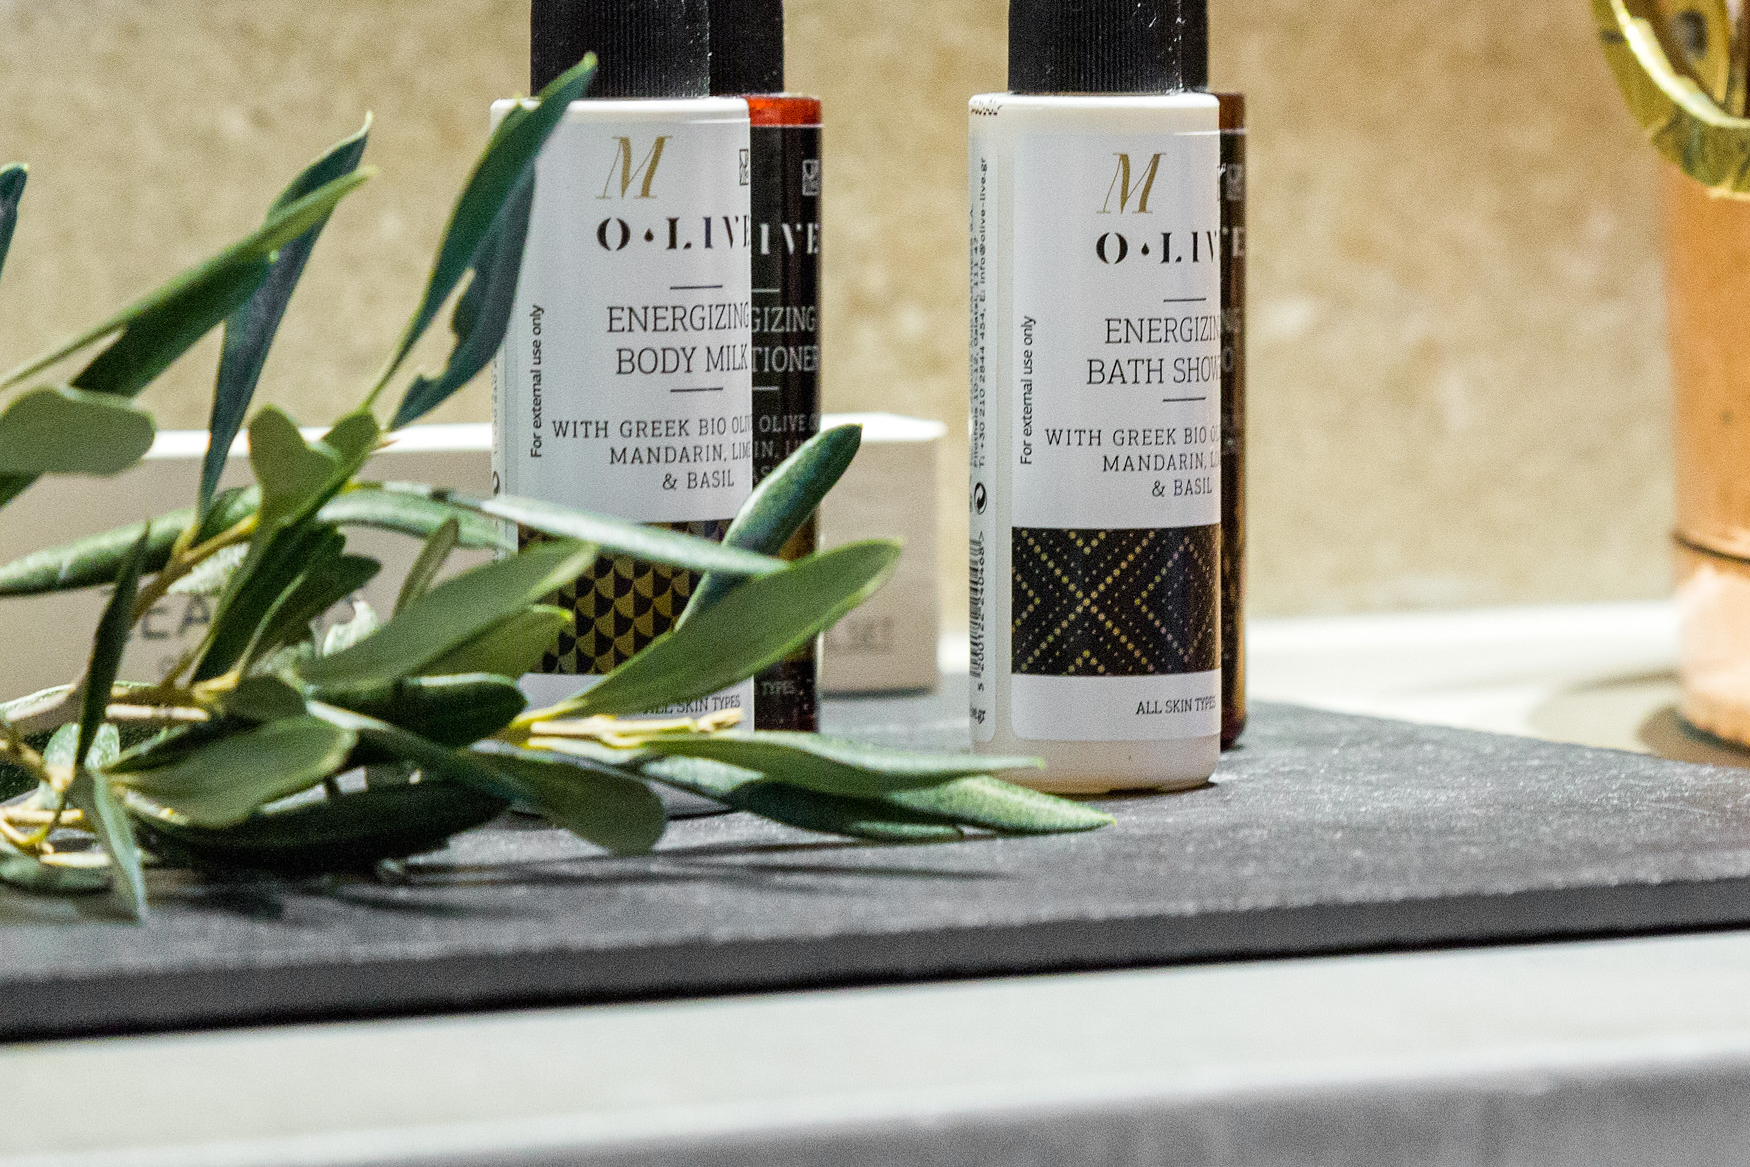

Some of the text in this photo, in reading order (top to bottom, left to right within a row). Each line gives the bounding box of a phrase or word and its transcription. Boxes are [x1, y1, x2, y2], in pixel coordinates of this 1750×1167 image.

[595, 136, 673, 199] M
[1096, 152, 1167, 214] M
[760, 221, 820, 255] IVE
[606, 302, 749, 333] ENERGIZING
[752, 306, 816, 333] GIZING
[1104, 315, 1220, 345] ENERGIZIN
[616, 344, 748, 375] BODY MILK
[1086, 358, 1165, 385] BATH
[1172, 355, 1220, 384] SHOW
[529, 304, 544, 459] For external use only
[1020, 315, 1036, 465] For external use only
[552, 420, 609, 439] WITH
[619, 419, 690, 439] GREEK
[698, 417, 727, 436] BIO
[1044, 428, 1102, 447] WITH
[1112, 427, 1177, 447] GREEK
[1184, 425, 1207, 445] BIO
[609, 443, 727, 465] MANDARIN,
[1102, 451, 1207, 472] MANDARIN,
[662, 473, 677, 490] &
[687, 470, 734, 490] BASIL
[1152, 477, 1213, 498] & BASIL
[712, 694, 741, 712] TYPES
[1136, 700, 1163, 715] ALL
[1165, 699, 1193, 714] SKIN
